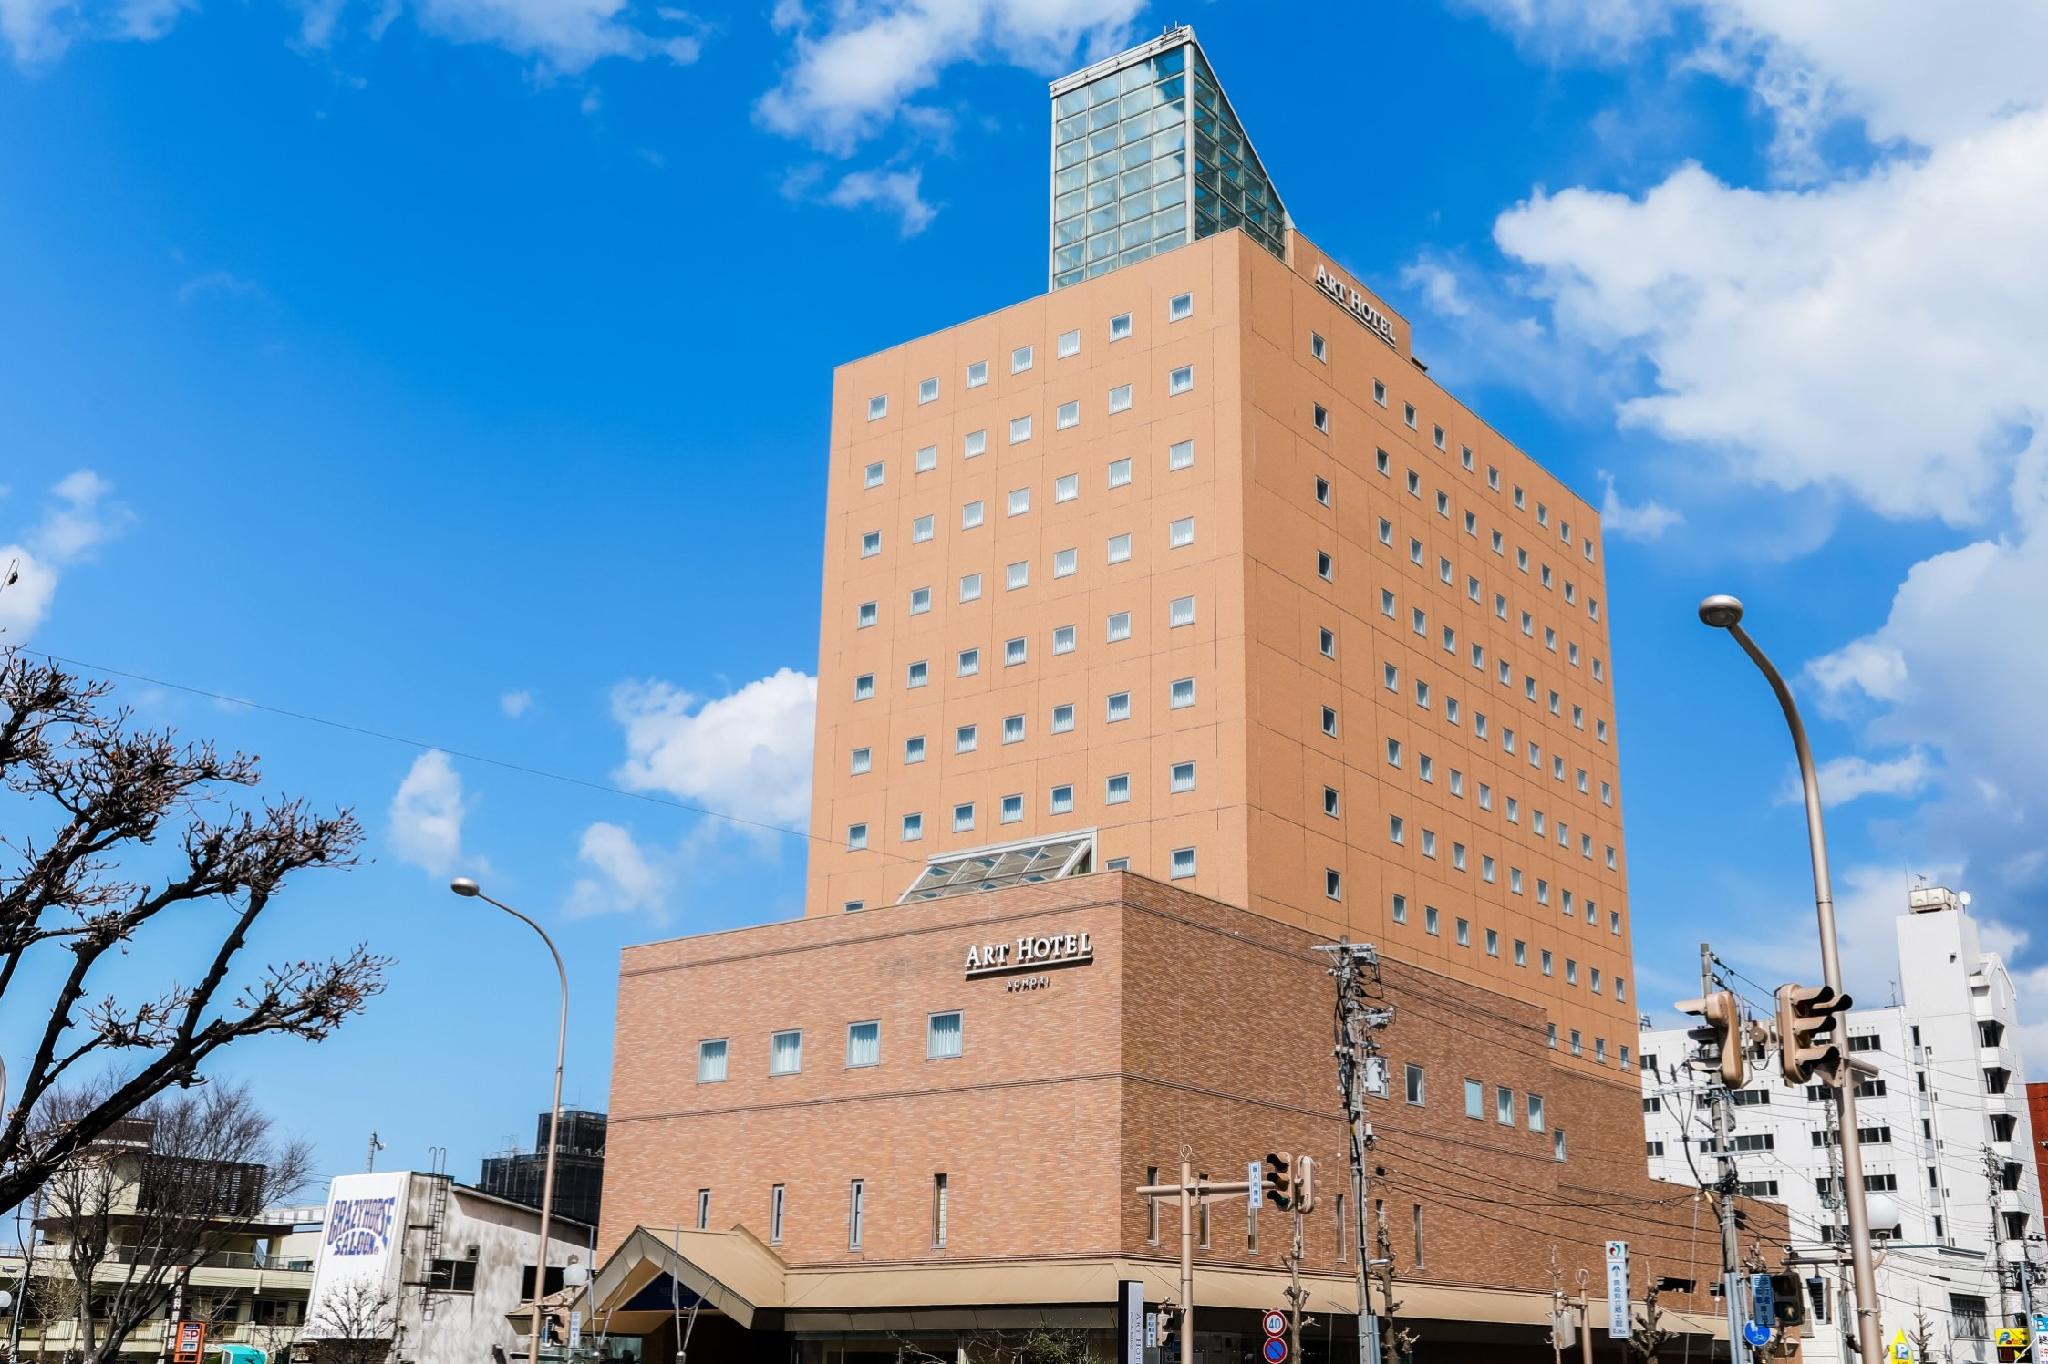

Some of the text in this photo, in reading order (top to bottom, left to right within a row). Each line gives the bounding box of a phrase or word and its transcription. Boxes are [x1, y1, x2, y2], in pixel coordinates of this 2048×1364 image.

[1316, 263, 1396, 342] ART HOTEL
[965, 933, 1092, 967] ART HOTEL
[1268, 1317, 1281, 1329] 40
